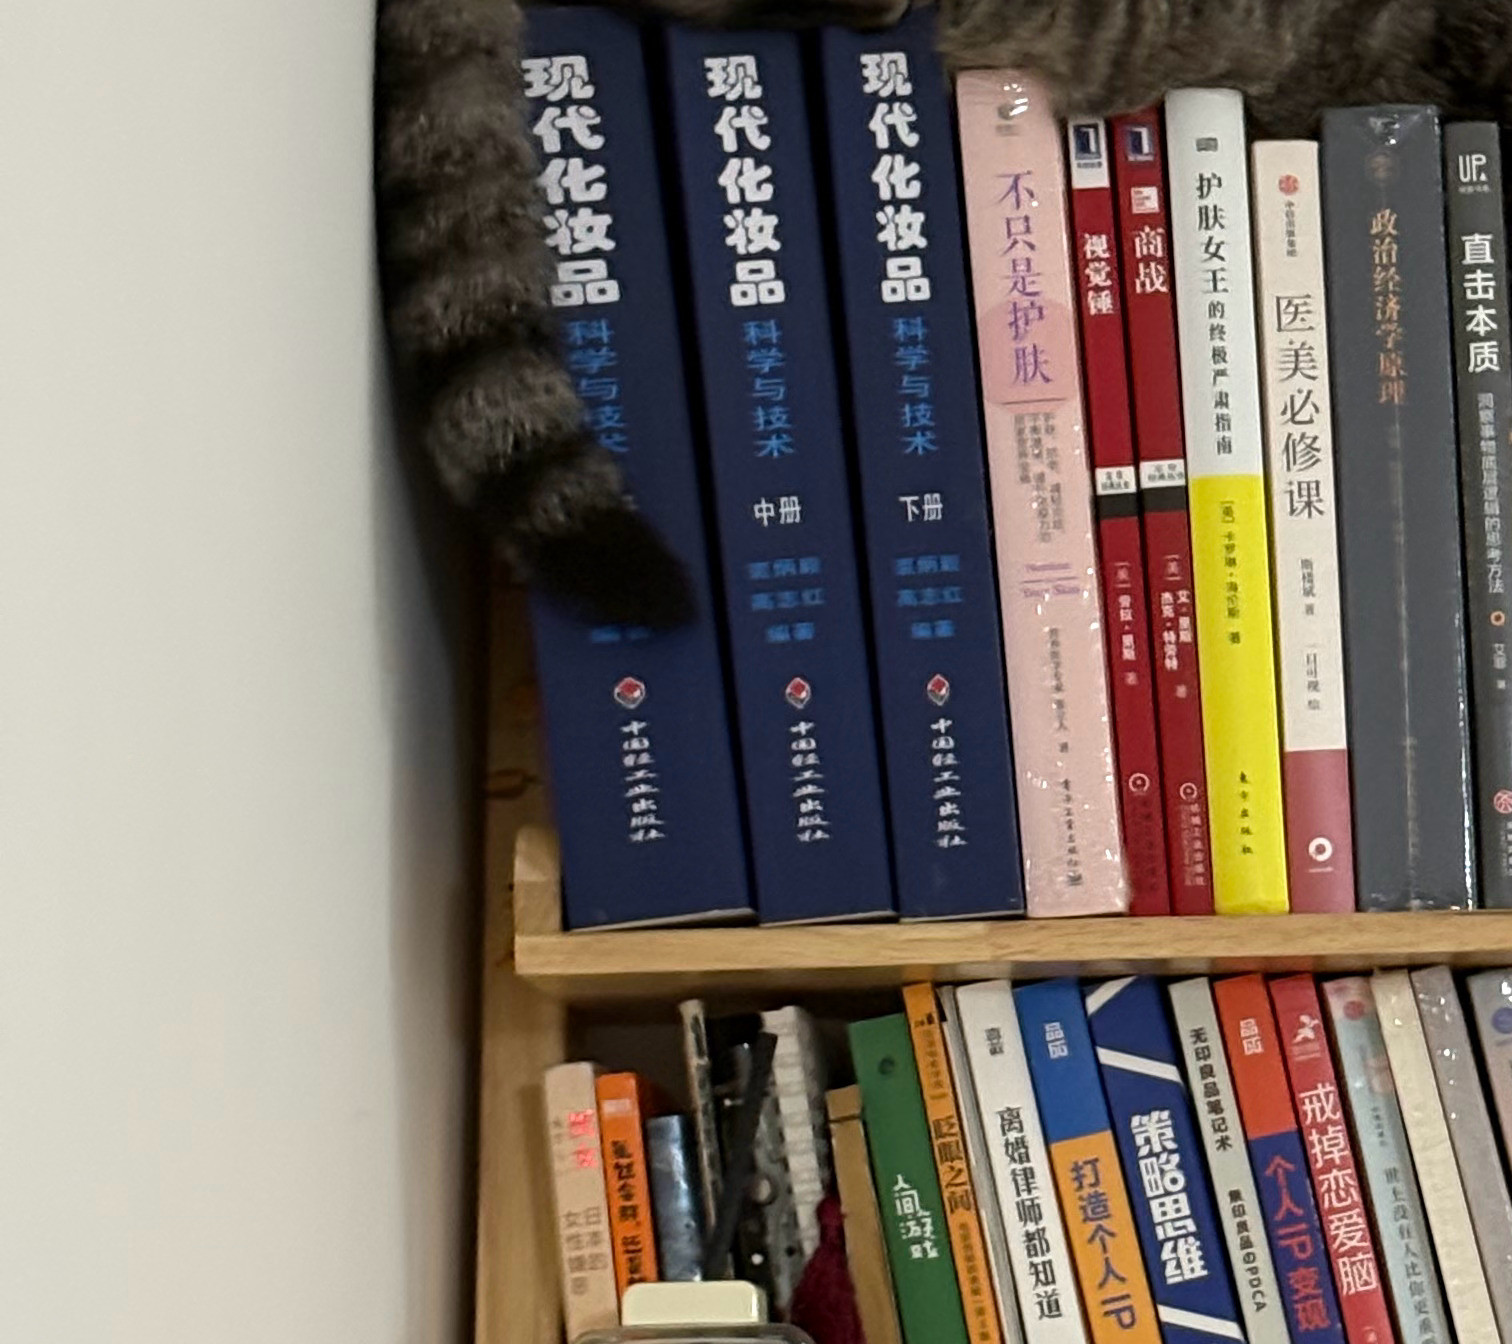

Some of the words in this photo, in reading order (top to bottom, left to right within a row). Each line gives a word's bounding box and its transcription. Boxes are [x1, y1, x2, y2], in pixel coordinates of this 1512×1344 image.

[521, 55, 621, 307] 现代化妆品
[703, 55, 786, 307] 现代化妆品
[859, 51, 932, 304] 现代化妆品
[1134, 226, 1170, 294] 商战
[994, 169, 1053, 386] 不只是护肤
[1083, 233, 1116, 316] 视觉锤
[1195, 172, 1234, 456] 护肤女王的终极严肃指南
[1368, 207, 1407, 406] 政治经济学原理
[1460, 232, 1501, 375] 直击本质
[742, 320, 794, 458] 科学与技术
[892, 317, 938, 456] 科学与技术
[1275, 294, 1327, 519] 医美必修课
[753, 495, 801, 527] 中册
[899, 492, 943, 523] 下册
[621, 719, 666, 843] 中国轻工业出版社
[790, 719, 831, 844] 中国轻工业出版社
[930, 717, 969, 848] 中国轻工业出版社
[892, 1174, 940, 1260] 人间游戏
[998, 1106, 1063, 1320] 离婚律师都知道
[1070, 1157, 1137, 1330] 打造个人IP
[1130, 1110, 1208, 1285] 策略思维
[1265, 1154, 1331, 1331] 个人IP变现
[1299, 1082, 1379, 1296] 戒掉恋爱脑
